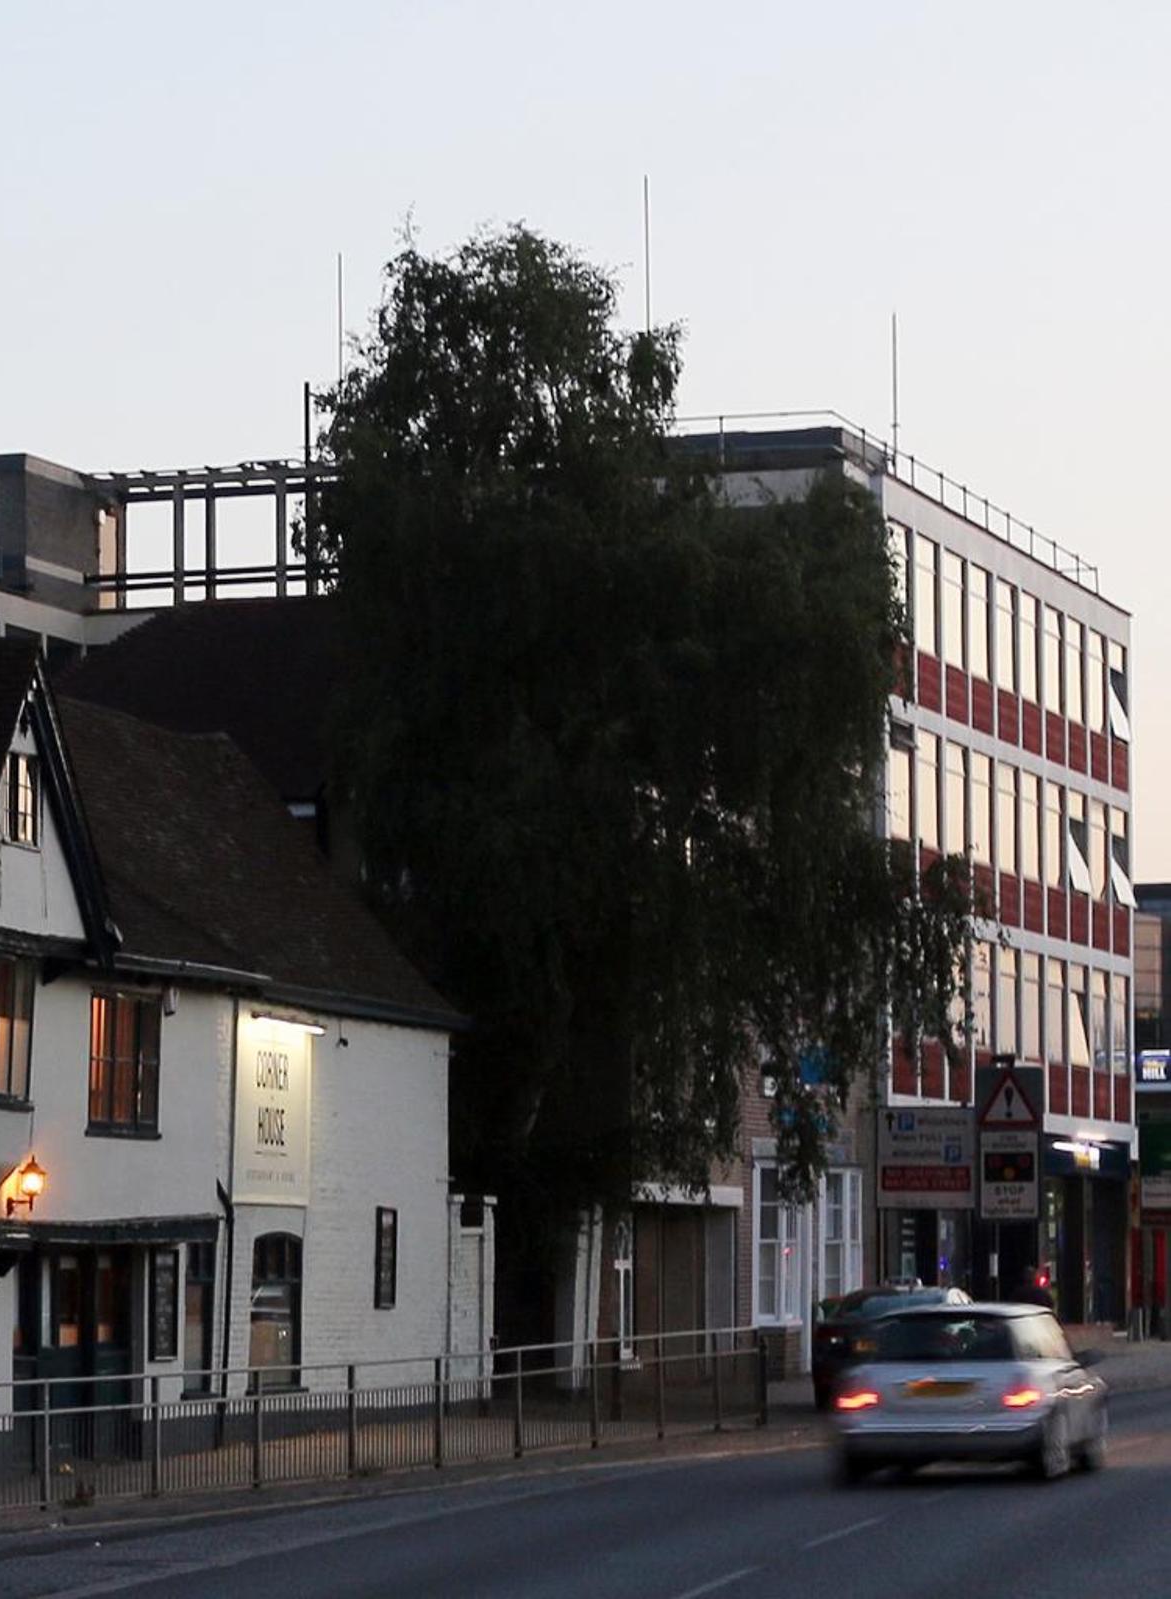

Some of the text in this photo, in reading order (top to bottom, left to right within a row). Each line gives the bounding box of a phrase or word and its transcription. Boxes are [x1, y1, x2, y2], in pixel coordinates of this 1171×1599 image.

[256, 1050, 289, 1091] CORNER
[257, 1106, 285, 1146] HOUSE
[994, 1185, 1025, 1195] STOP
